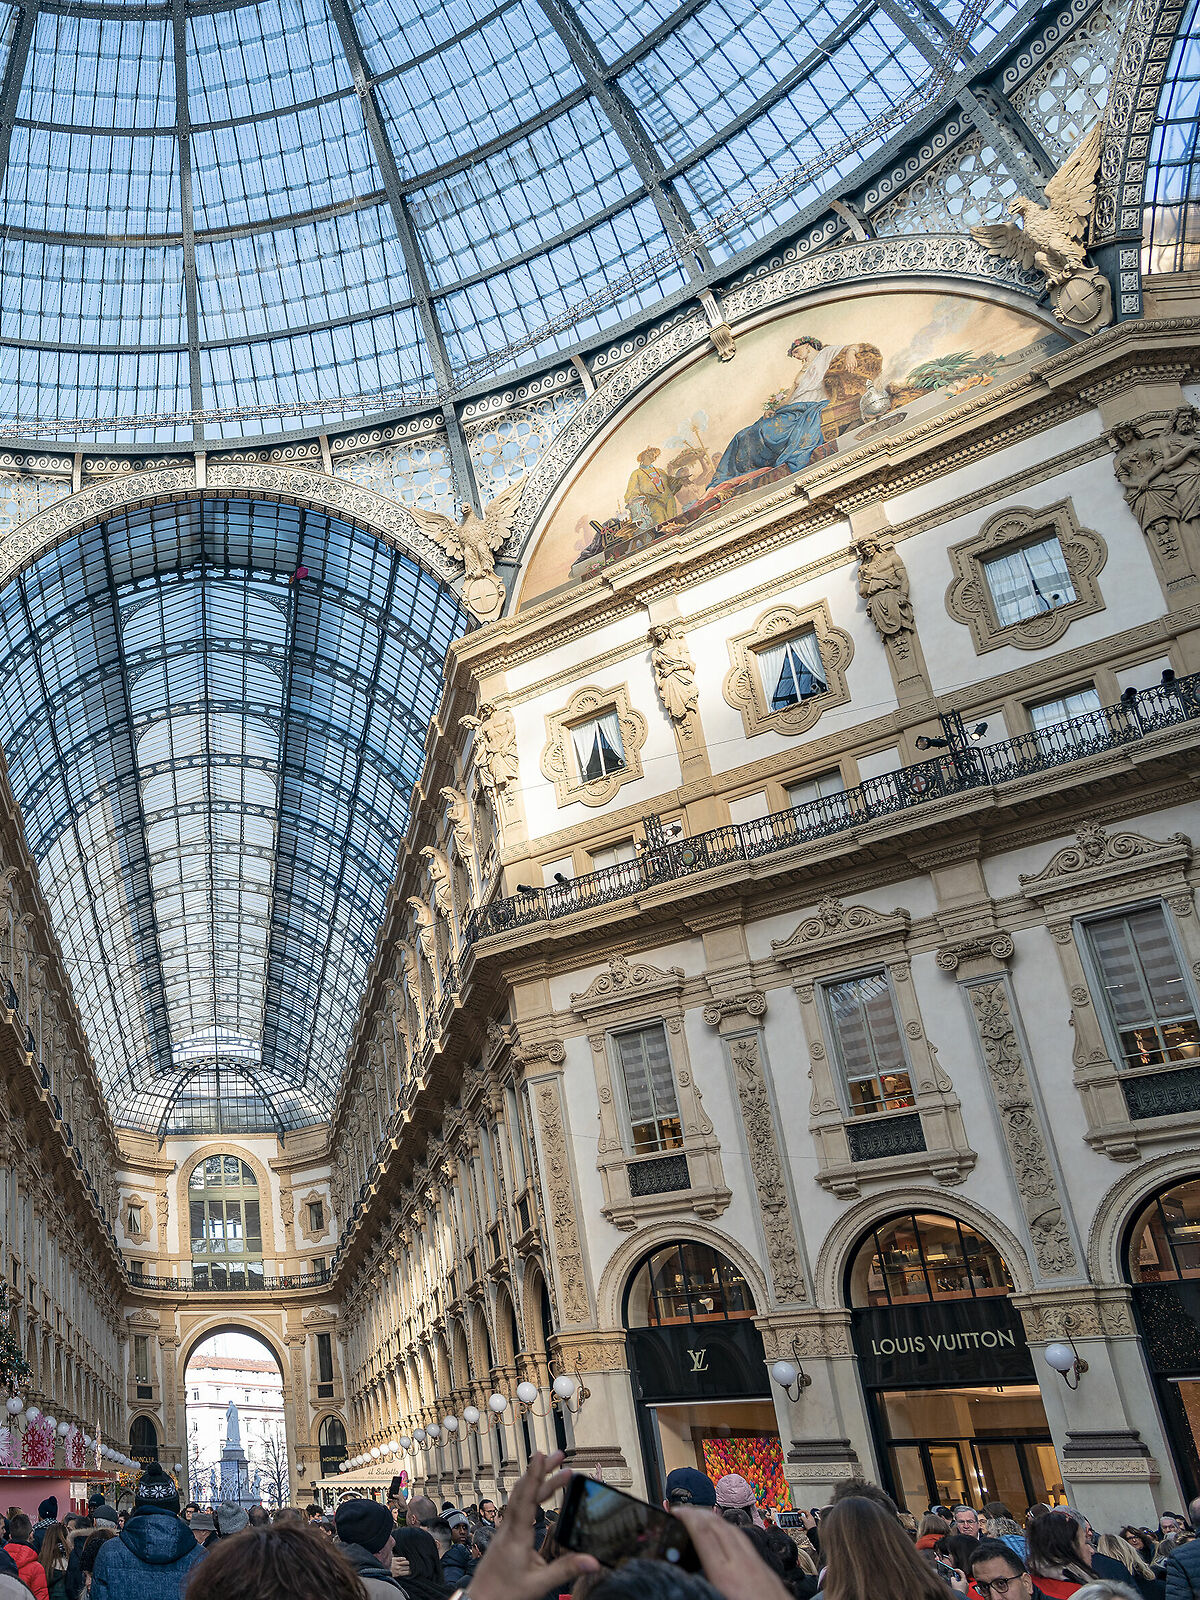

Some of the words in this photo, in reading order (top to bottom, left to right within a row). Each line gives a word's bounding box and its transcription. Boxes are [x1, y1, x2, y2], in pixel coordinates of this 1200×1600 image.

[871, 1336, 926, 1355] LOUIS
[928, 1329, 1016, 1352] VUITTON
[376, 1467, 400, 1476] Salotto
